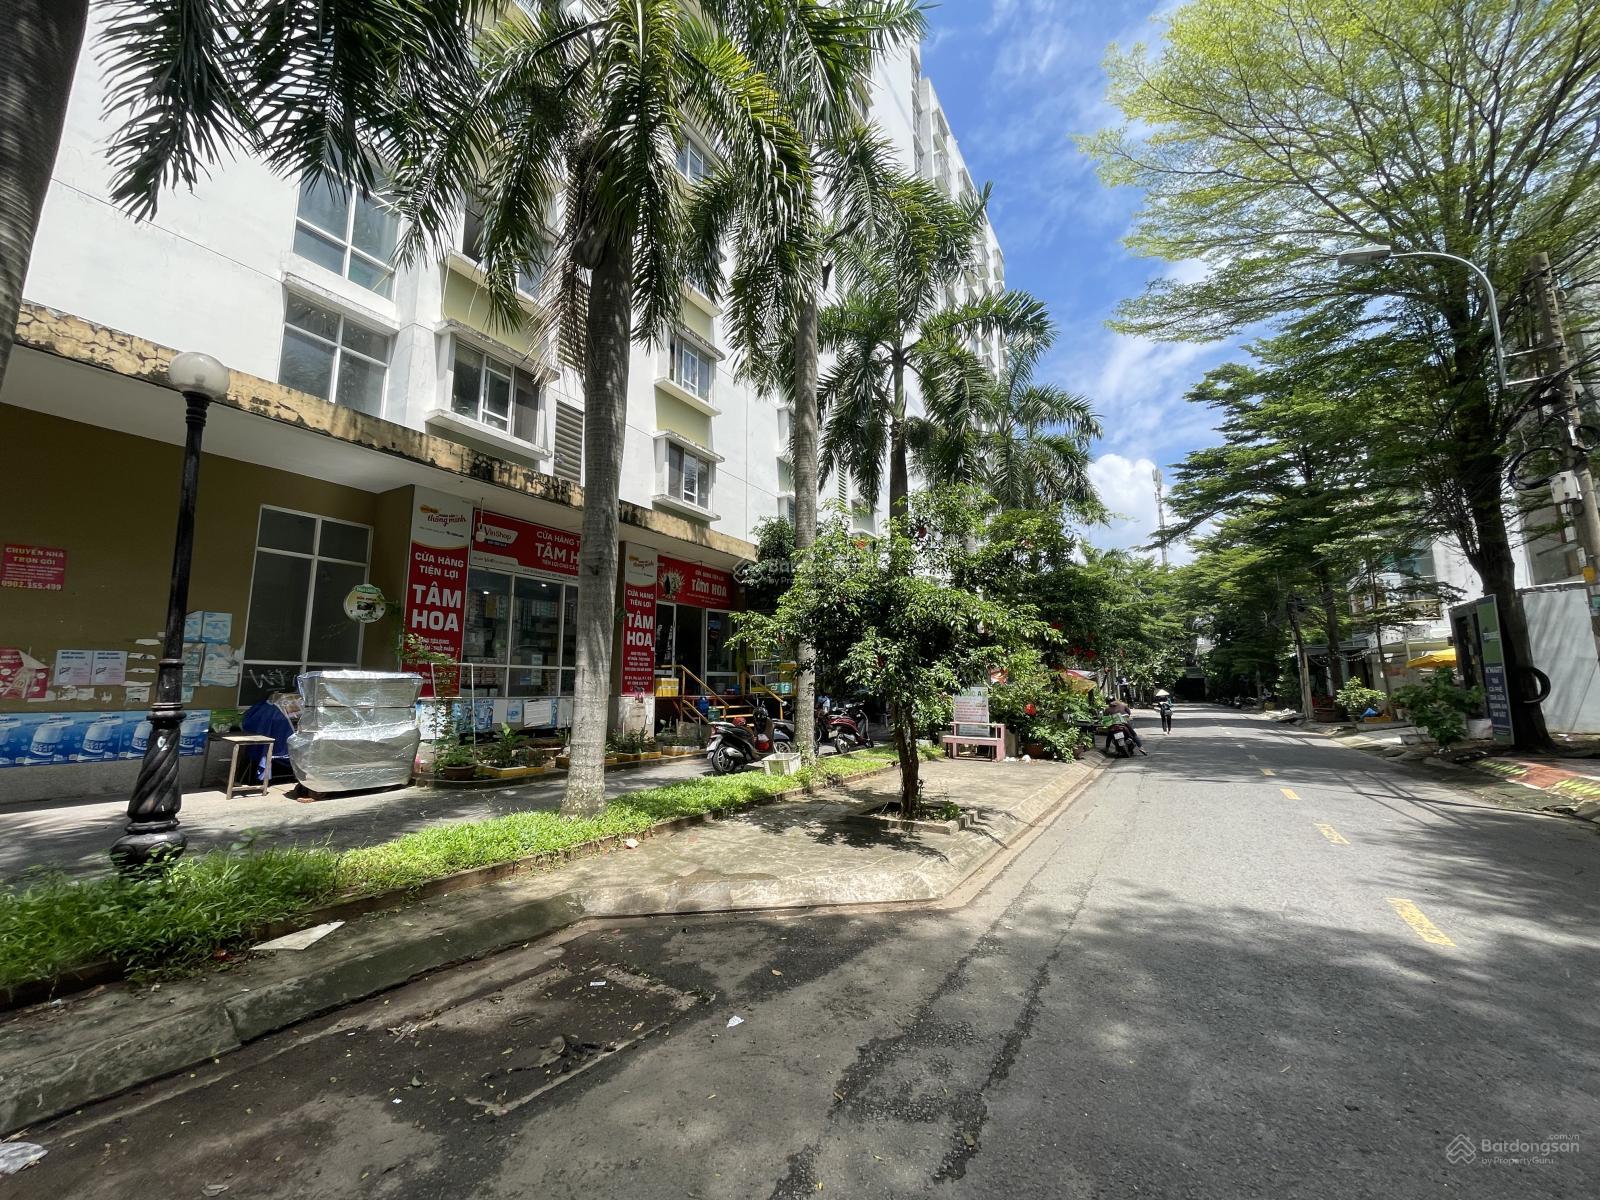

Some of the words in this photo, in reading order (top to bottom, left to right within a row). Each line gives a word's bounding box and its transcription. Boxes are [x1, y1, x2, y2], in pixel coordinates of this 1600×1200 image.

[484, 525, 512, 542] VinShop
[536, 530, 553, 542] CỬA
[554, 535, 575, 546] HÀNG
[415, 551, 435, 563] CỬA
[437, 555, 465, 568] HÀNG
[535, 541, 567, 562] TÂM
[419, 564, 442, 577] TIỆN
[444, 568, 460, 580] LỢI
[412, 581, 462, 609] TÂM
[711, 583, 727, 598] HOA
[411, 609, 459, 632] HOA
[627, 610, 653, 629] TÂM
[627, 630, 652, 646] HOA
